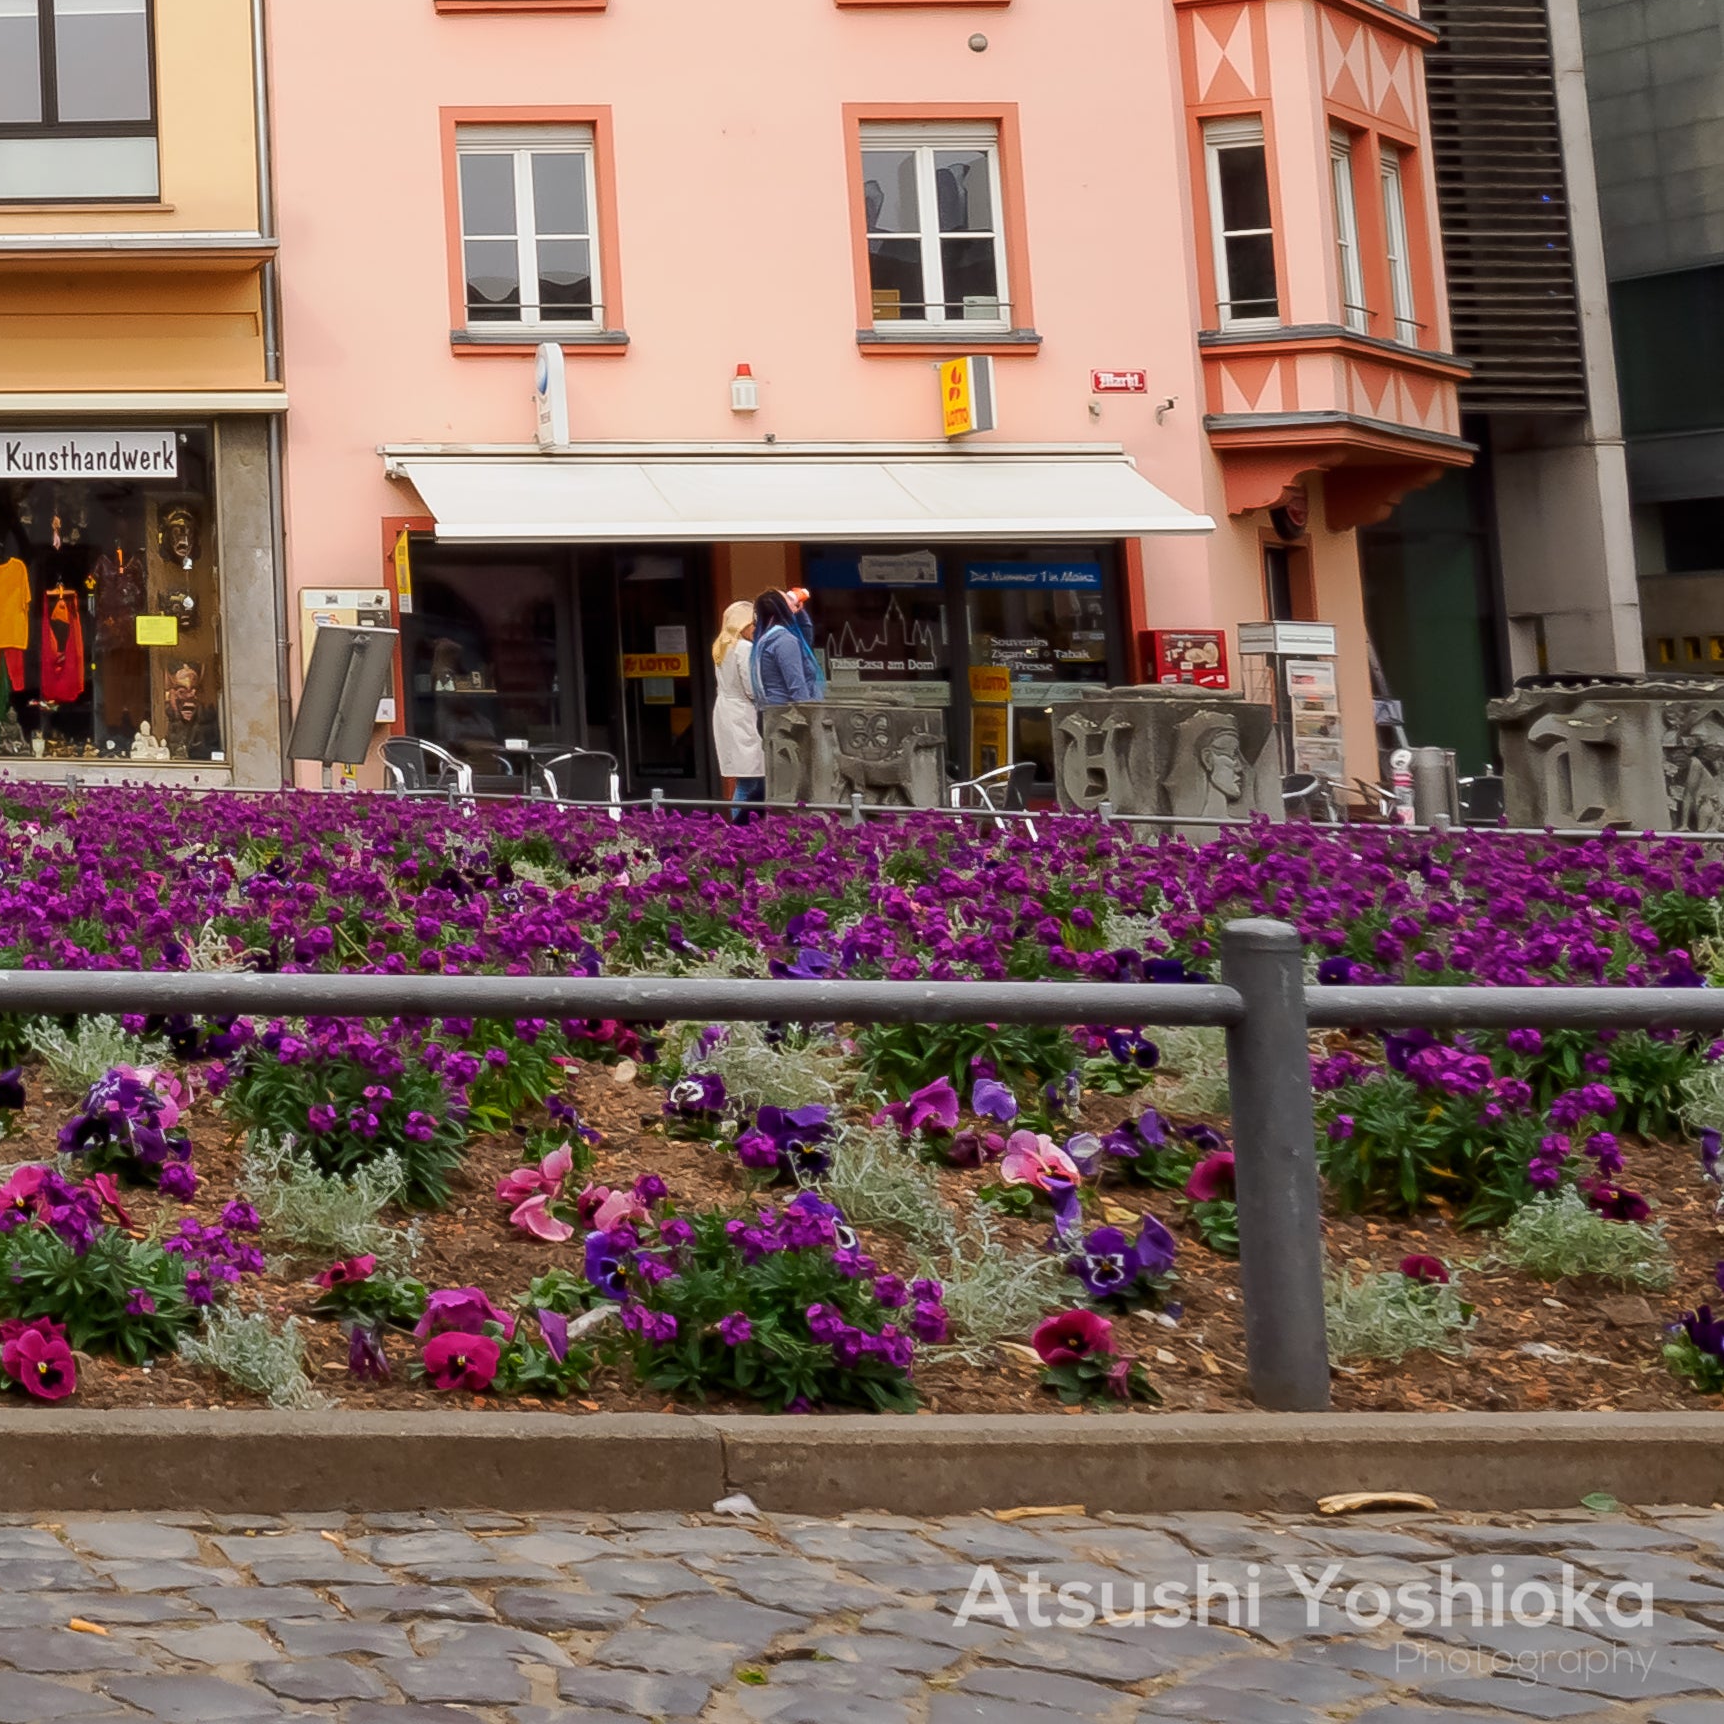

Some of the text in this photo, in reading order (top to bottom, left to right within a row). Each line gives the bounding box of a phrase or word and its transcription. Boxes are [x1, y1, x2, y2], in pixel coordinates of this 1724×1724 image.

[946, 407, 969, 428] LOTTO
[5, 440, 176, 474] Kunsthandwerk
[990, 636, 1049, 647] Souvenirs
[1052, 649, 1091, 659] Tabak
[638, 657, 682, 672] LOTTO
[907, 658, 935, 671] Dom
[1014, 661, 1053, 672] Presse
